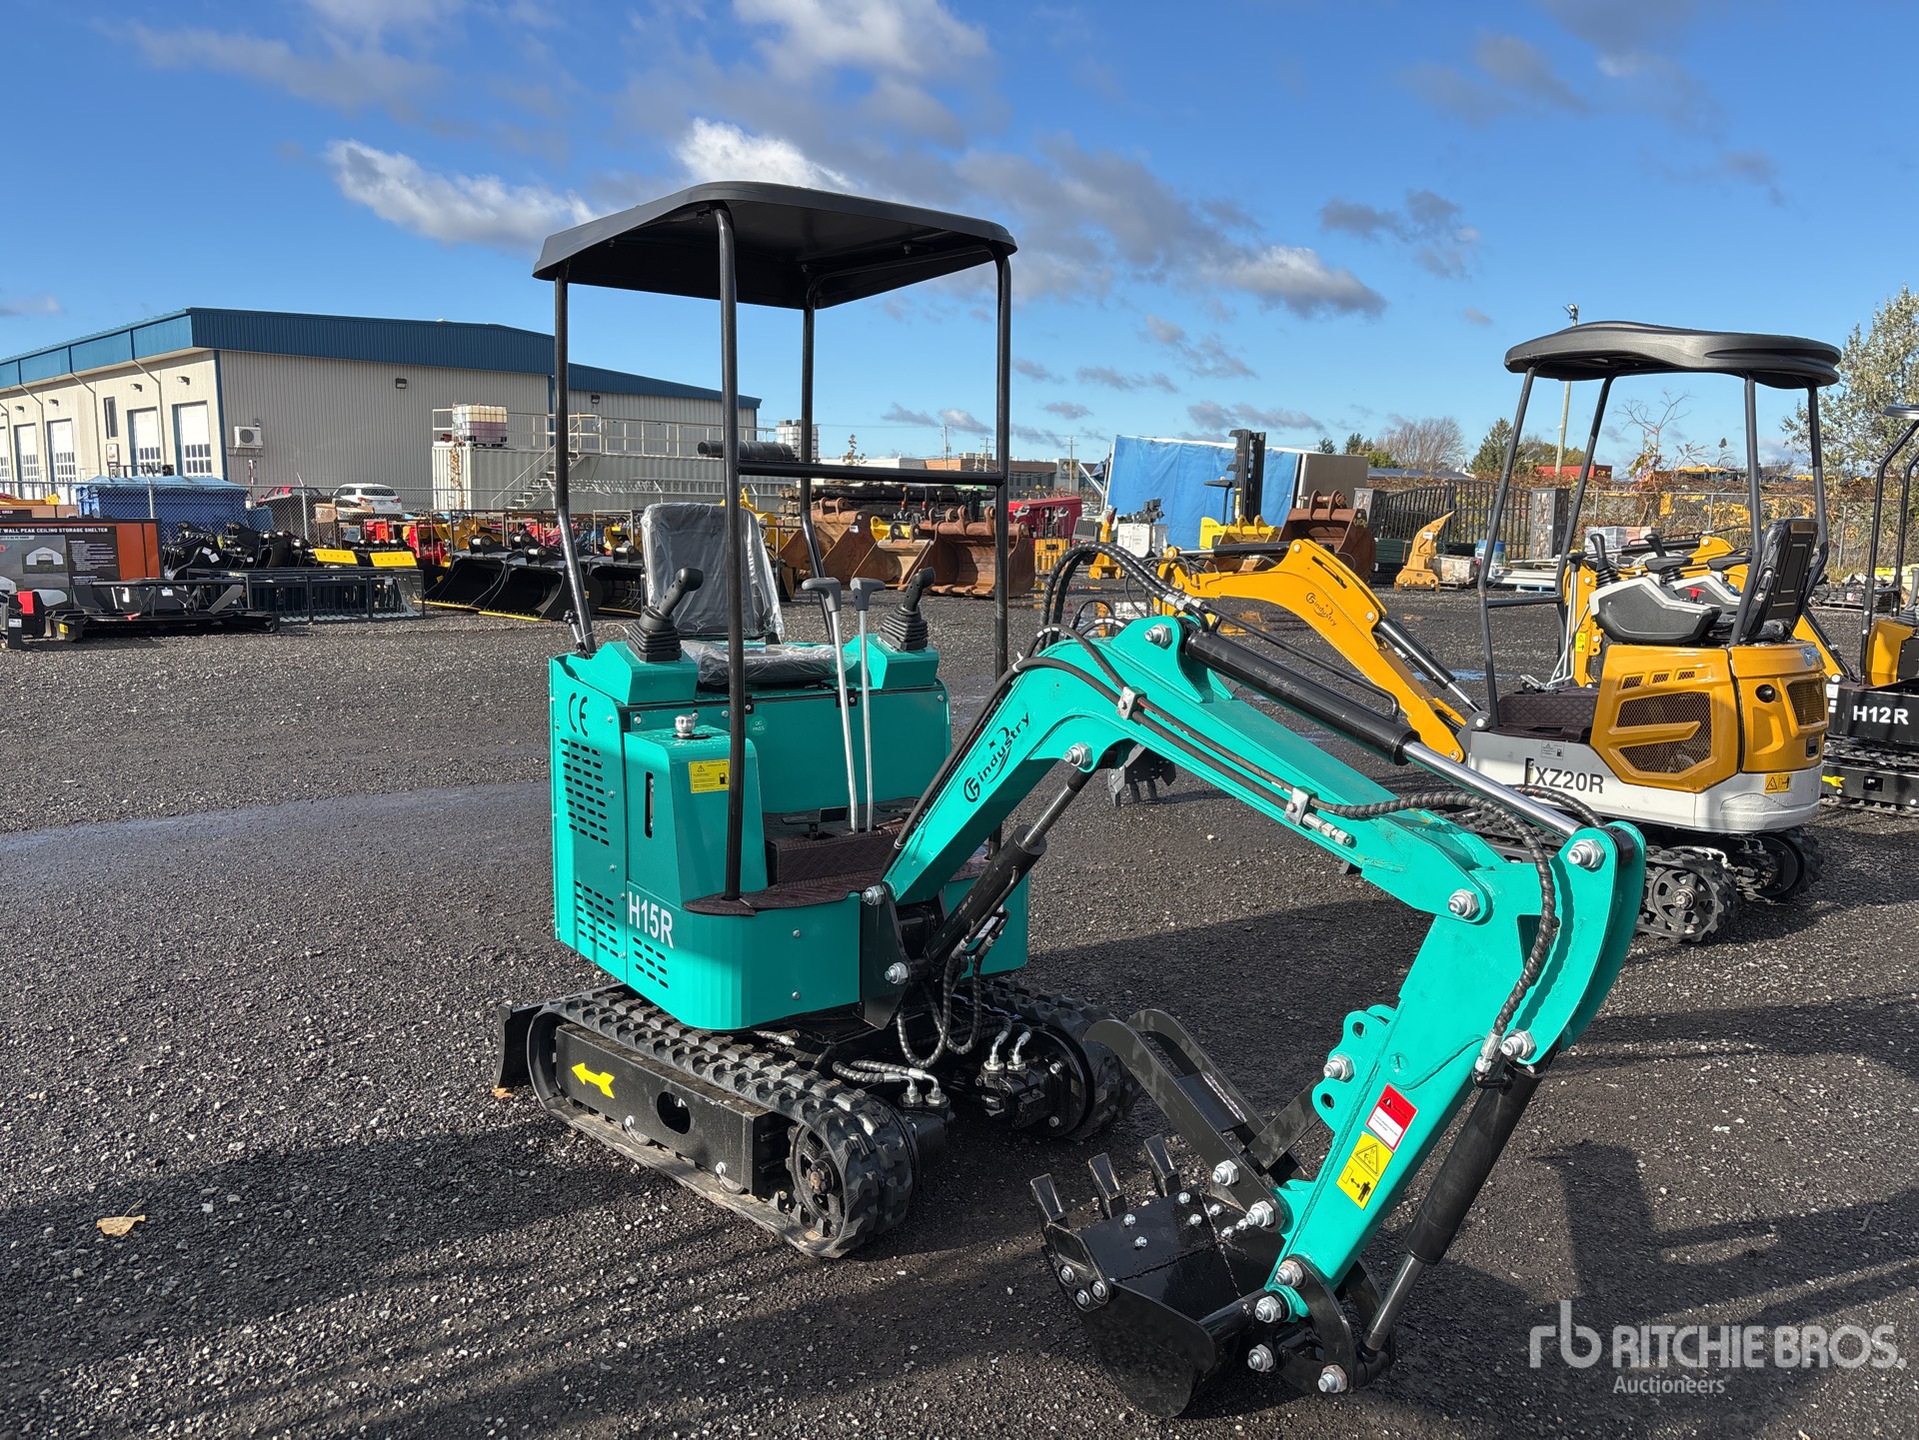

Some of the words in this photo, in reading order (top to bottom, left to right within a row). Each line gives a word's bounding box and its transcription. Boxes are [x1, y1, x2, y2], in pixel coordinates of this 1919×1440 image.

[568, 692, 588, 738] CE
[1853, 705, 1909, 725] H12R
[1535, 766, 1604, 794] XZ20R
[628, 890, 674, 949] H15R
